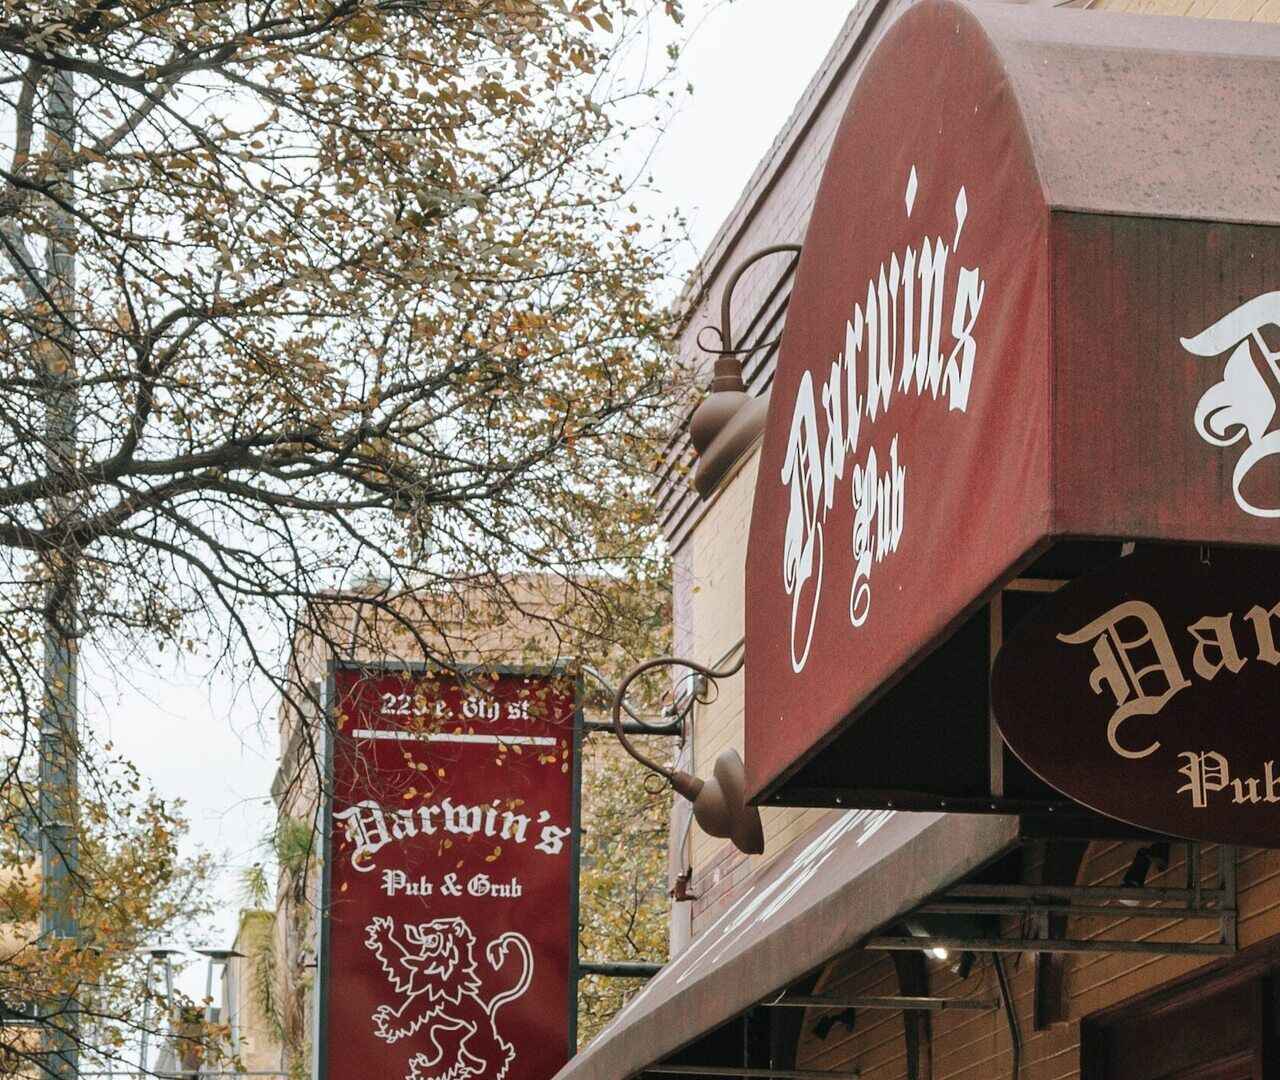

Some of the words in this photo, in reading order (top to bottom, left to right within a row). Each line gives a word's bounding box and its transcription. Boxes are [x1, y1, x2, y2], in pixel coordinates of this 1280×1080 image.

[781, 164, 985, 673] Darwin's
[850, 433, 906, 627] Pub
[333, 797, 572, 873] Darwin's
[380, 868, 434, 898] Pub
[440, 873, 463, 897] &
[467, 873, 522, 899] Grub
